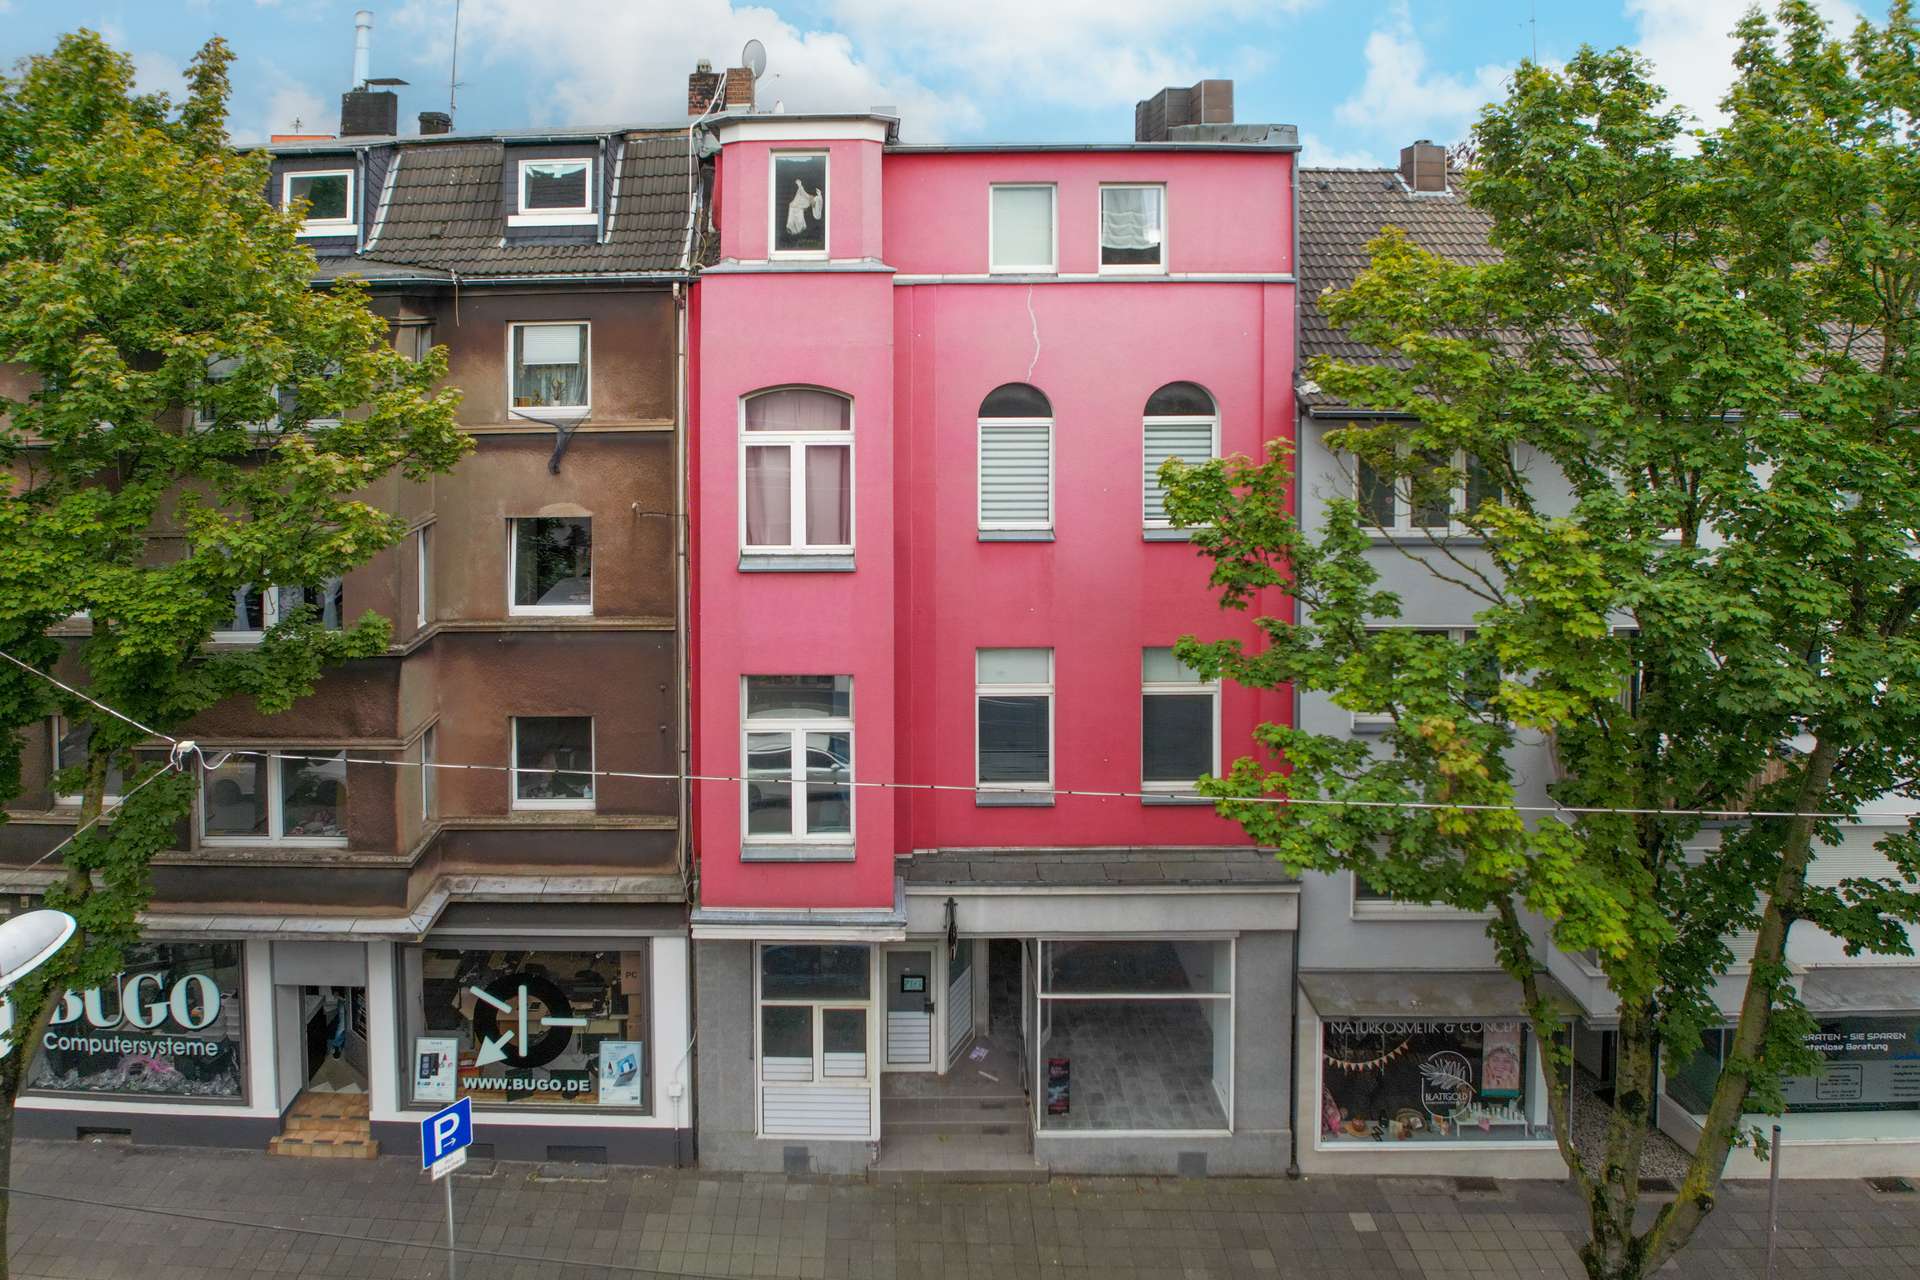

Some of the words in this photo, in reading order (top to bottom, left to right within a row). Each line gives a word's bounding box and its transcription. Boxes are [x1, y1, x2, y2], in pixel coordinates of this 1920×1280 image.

[1331, 1021, 1440, 1034] NATURKOSMETIK
[1460, 1021, 1521, 1033] CONCEPT
[1801, 1033, 1841, 1041] ERATEN
[1849, 1033, 1865, 1041] SIE
[1867, 1032, 1907, 1041] SPAREN
[43, 1032, 219, 1058] Computersysteme
[1846, 1043, 1889, 1052] Beratung
[462, 1077, 591, 1092] WWW.BUGO.DE
[434, 1111, 461, 1157] P
